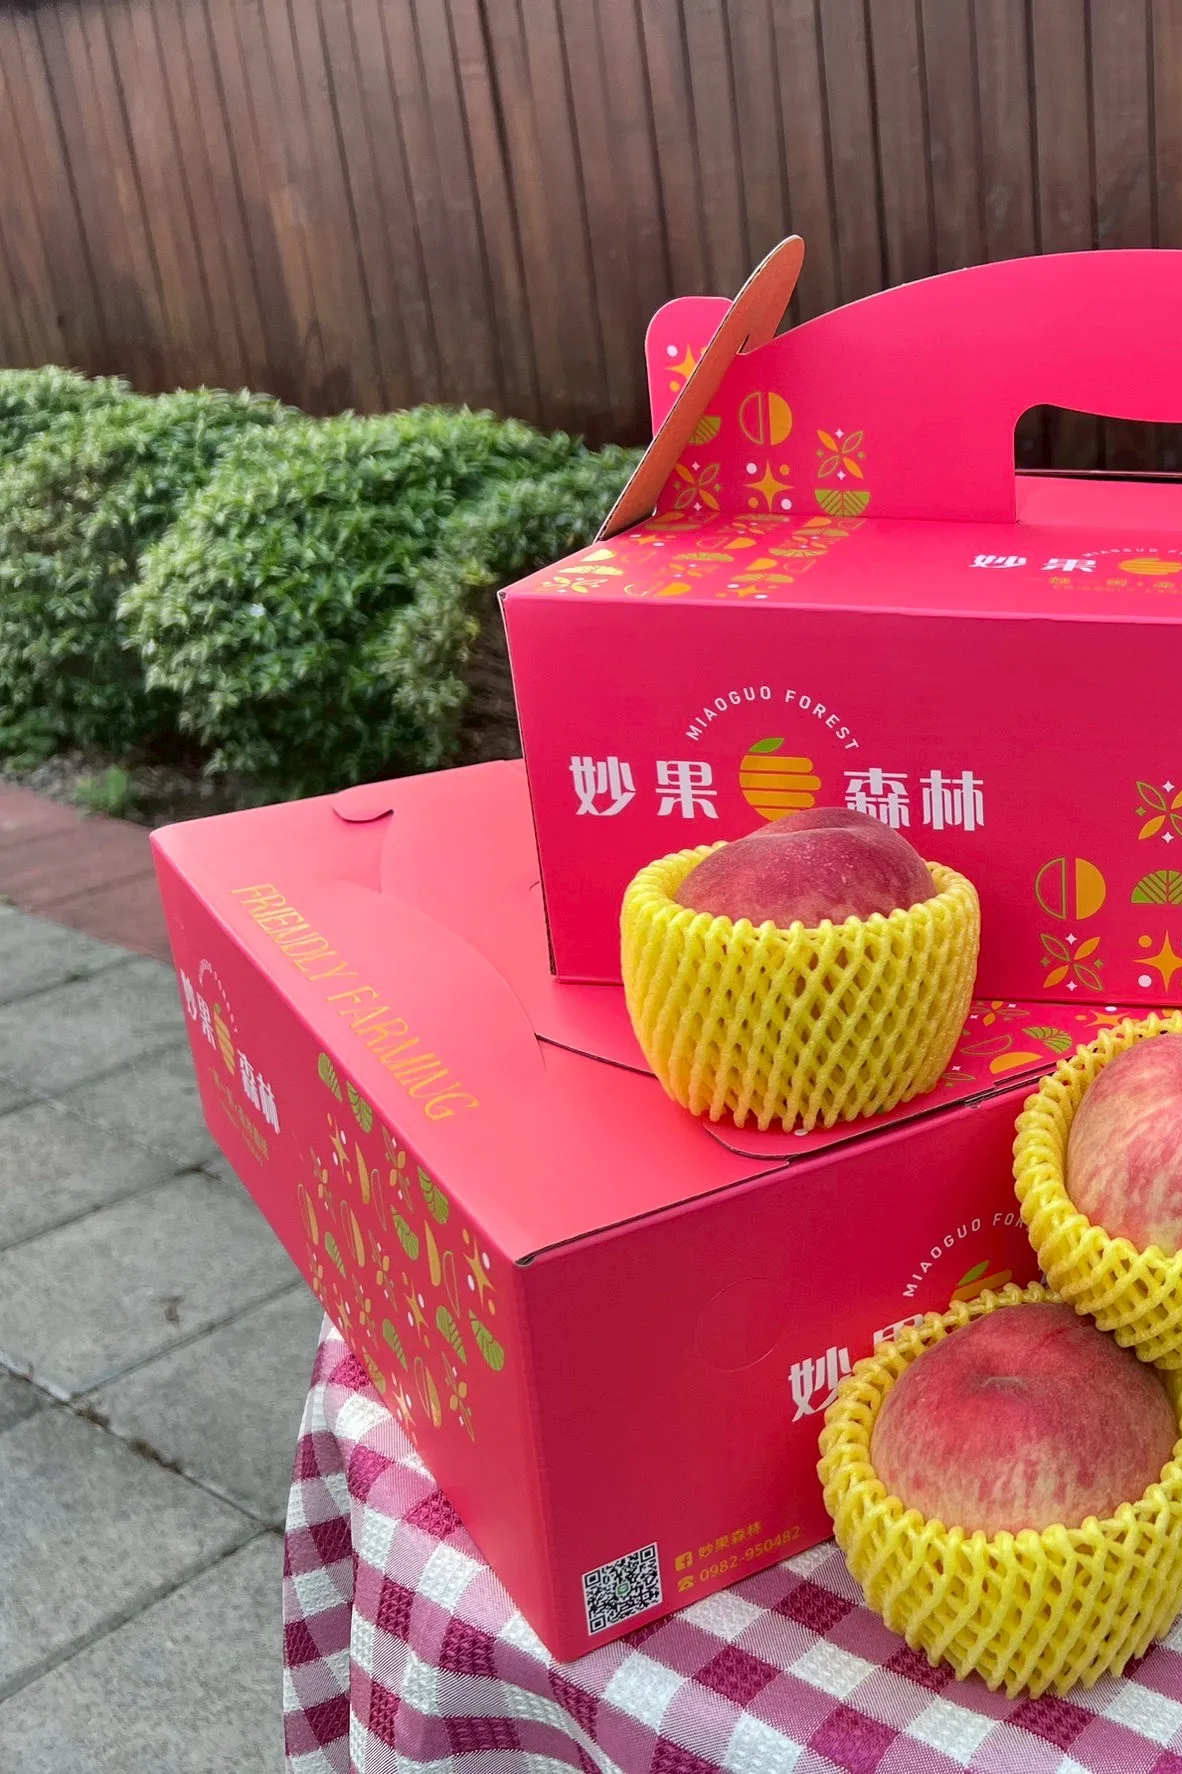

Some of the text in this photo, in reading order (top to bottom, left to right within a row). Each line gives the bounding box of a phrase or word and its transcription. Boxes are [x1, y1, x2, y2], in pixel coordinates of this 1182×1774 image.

[685, 685, 860, 752] MIAOGUO FOREST
[568, 755, 985, 831] 妙果 森林
[231, 883, 358, 982] FRIENDLY
[326, 985, 481, 1121] FARMING
[902, 1217, 982, 1298] MIAOGUO
[697, 1520, 763, 1561] 妙果森林
[699, 1525, 802, 1582] 0982-950482
